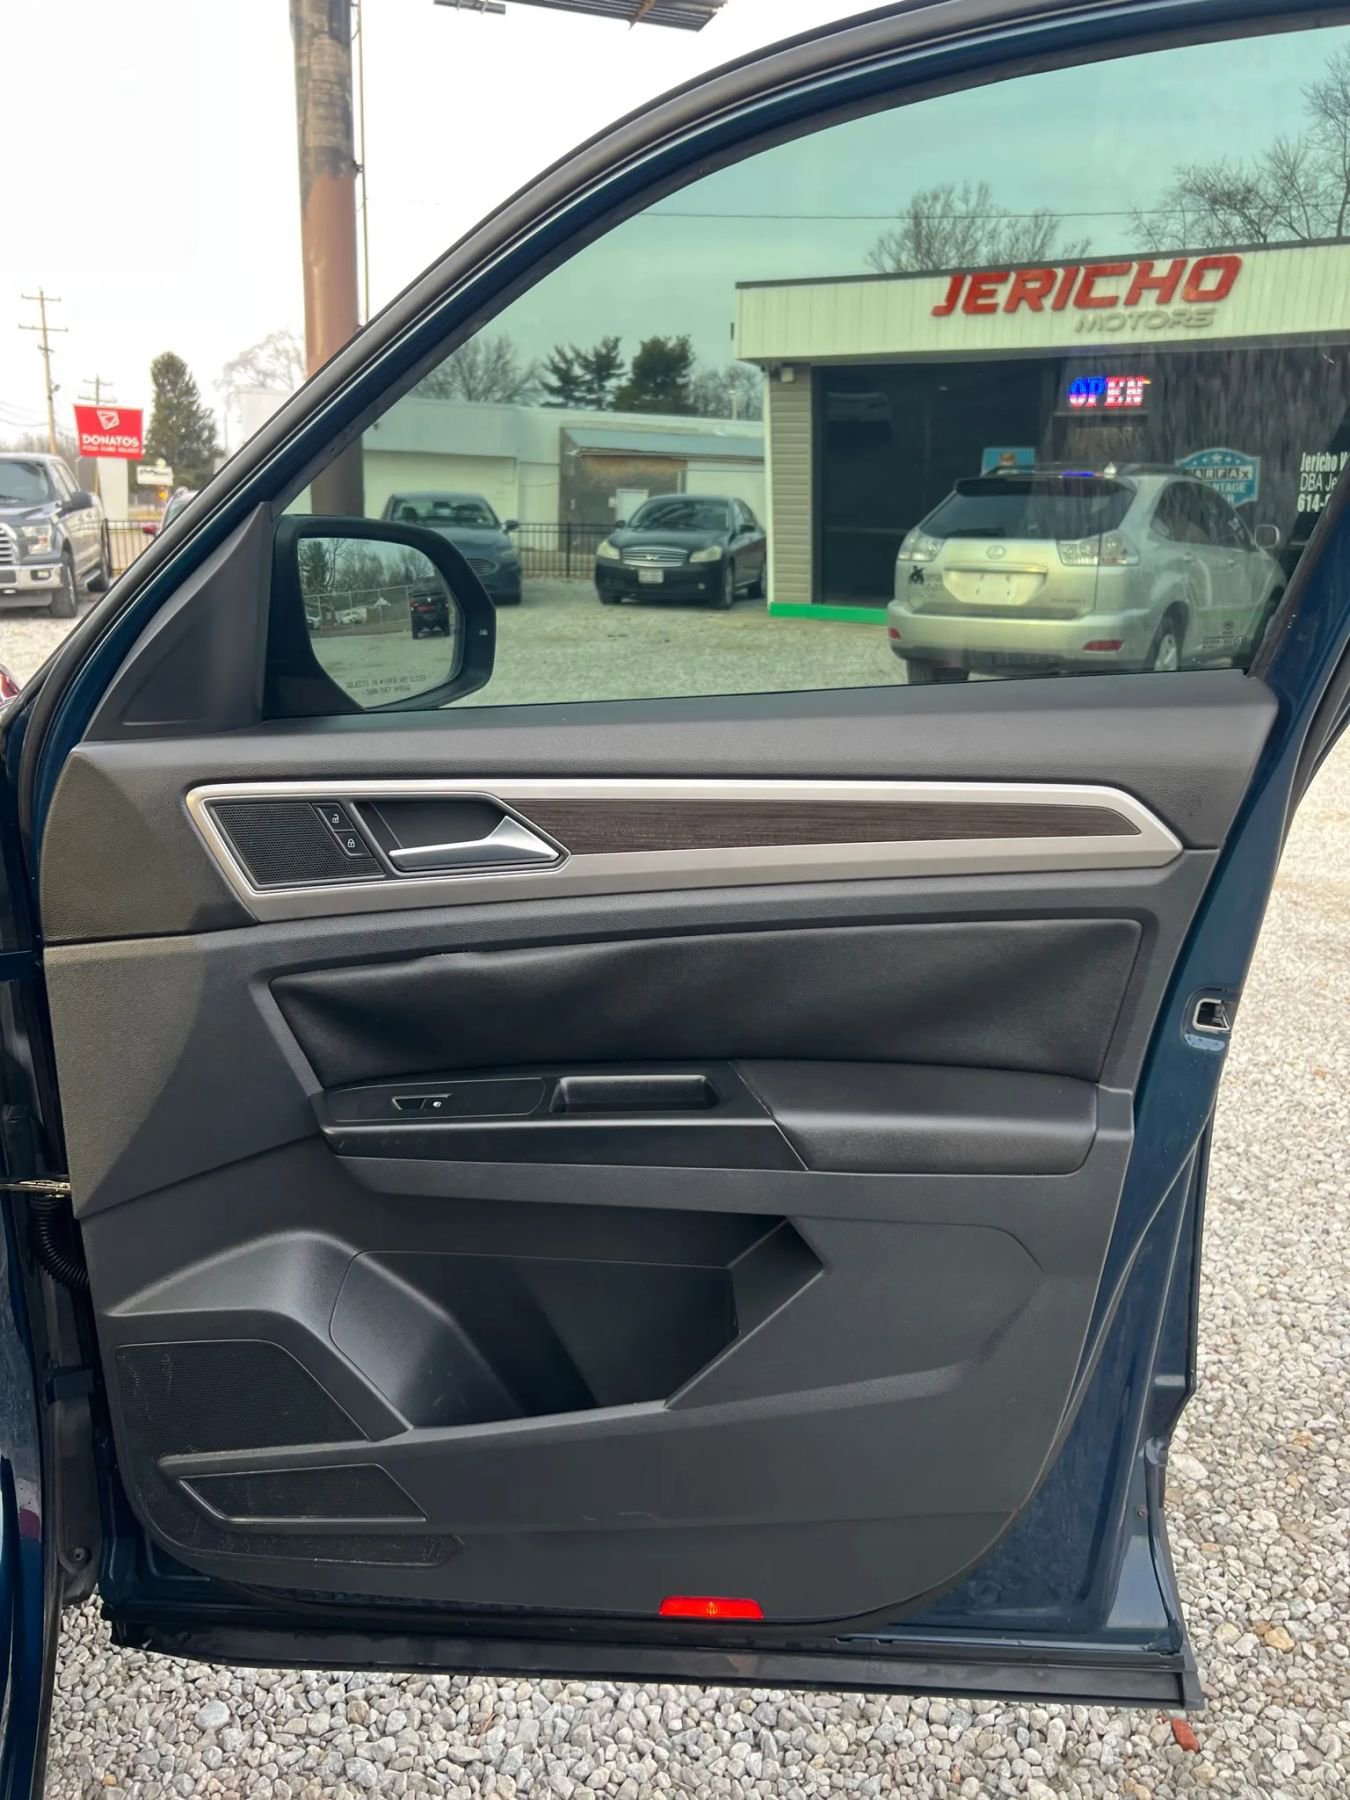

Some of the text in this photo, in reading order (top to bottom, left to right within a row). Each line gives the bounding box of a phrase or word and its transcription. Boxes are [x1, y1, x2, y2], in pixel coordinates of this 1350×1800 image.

[931, 255, 1242, 317] JERICHO
[1073, 308, 1217, 334] MOTORS
[1068, 376, 1147, 408] OPEN
[82, 434, 139, 448] DONATOS
[1300, 452, 1337, 472] Jericho
[1191, 466, 1252, 480] ARFAX
[1300, 472, 1323, 492] DBA
